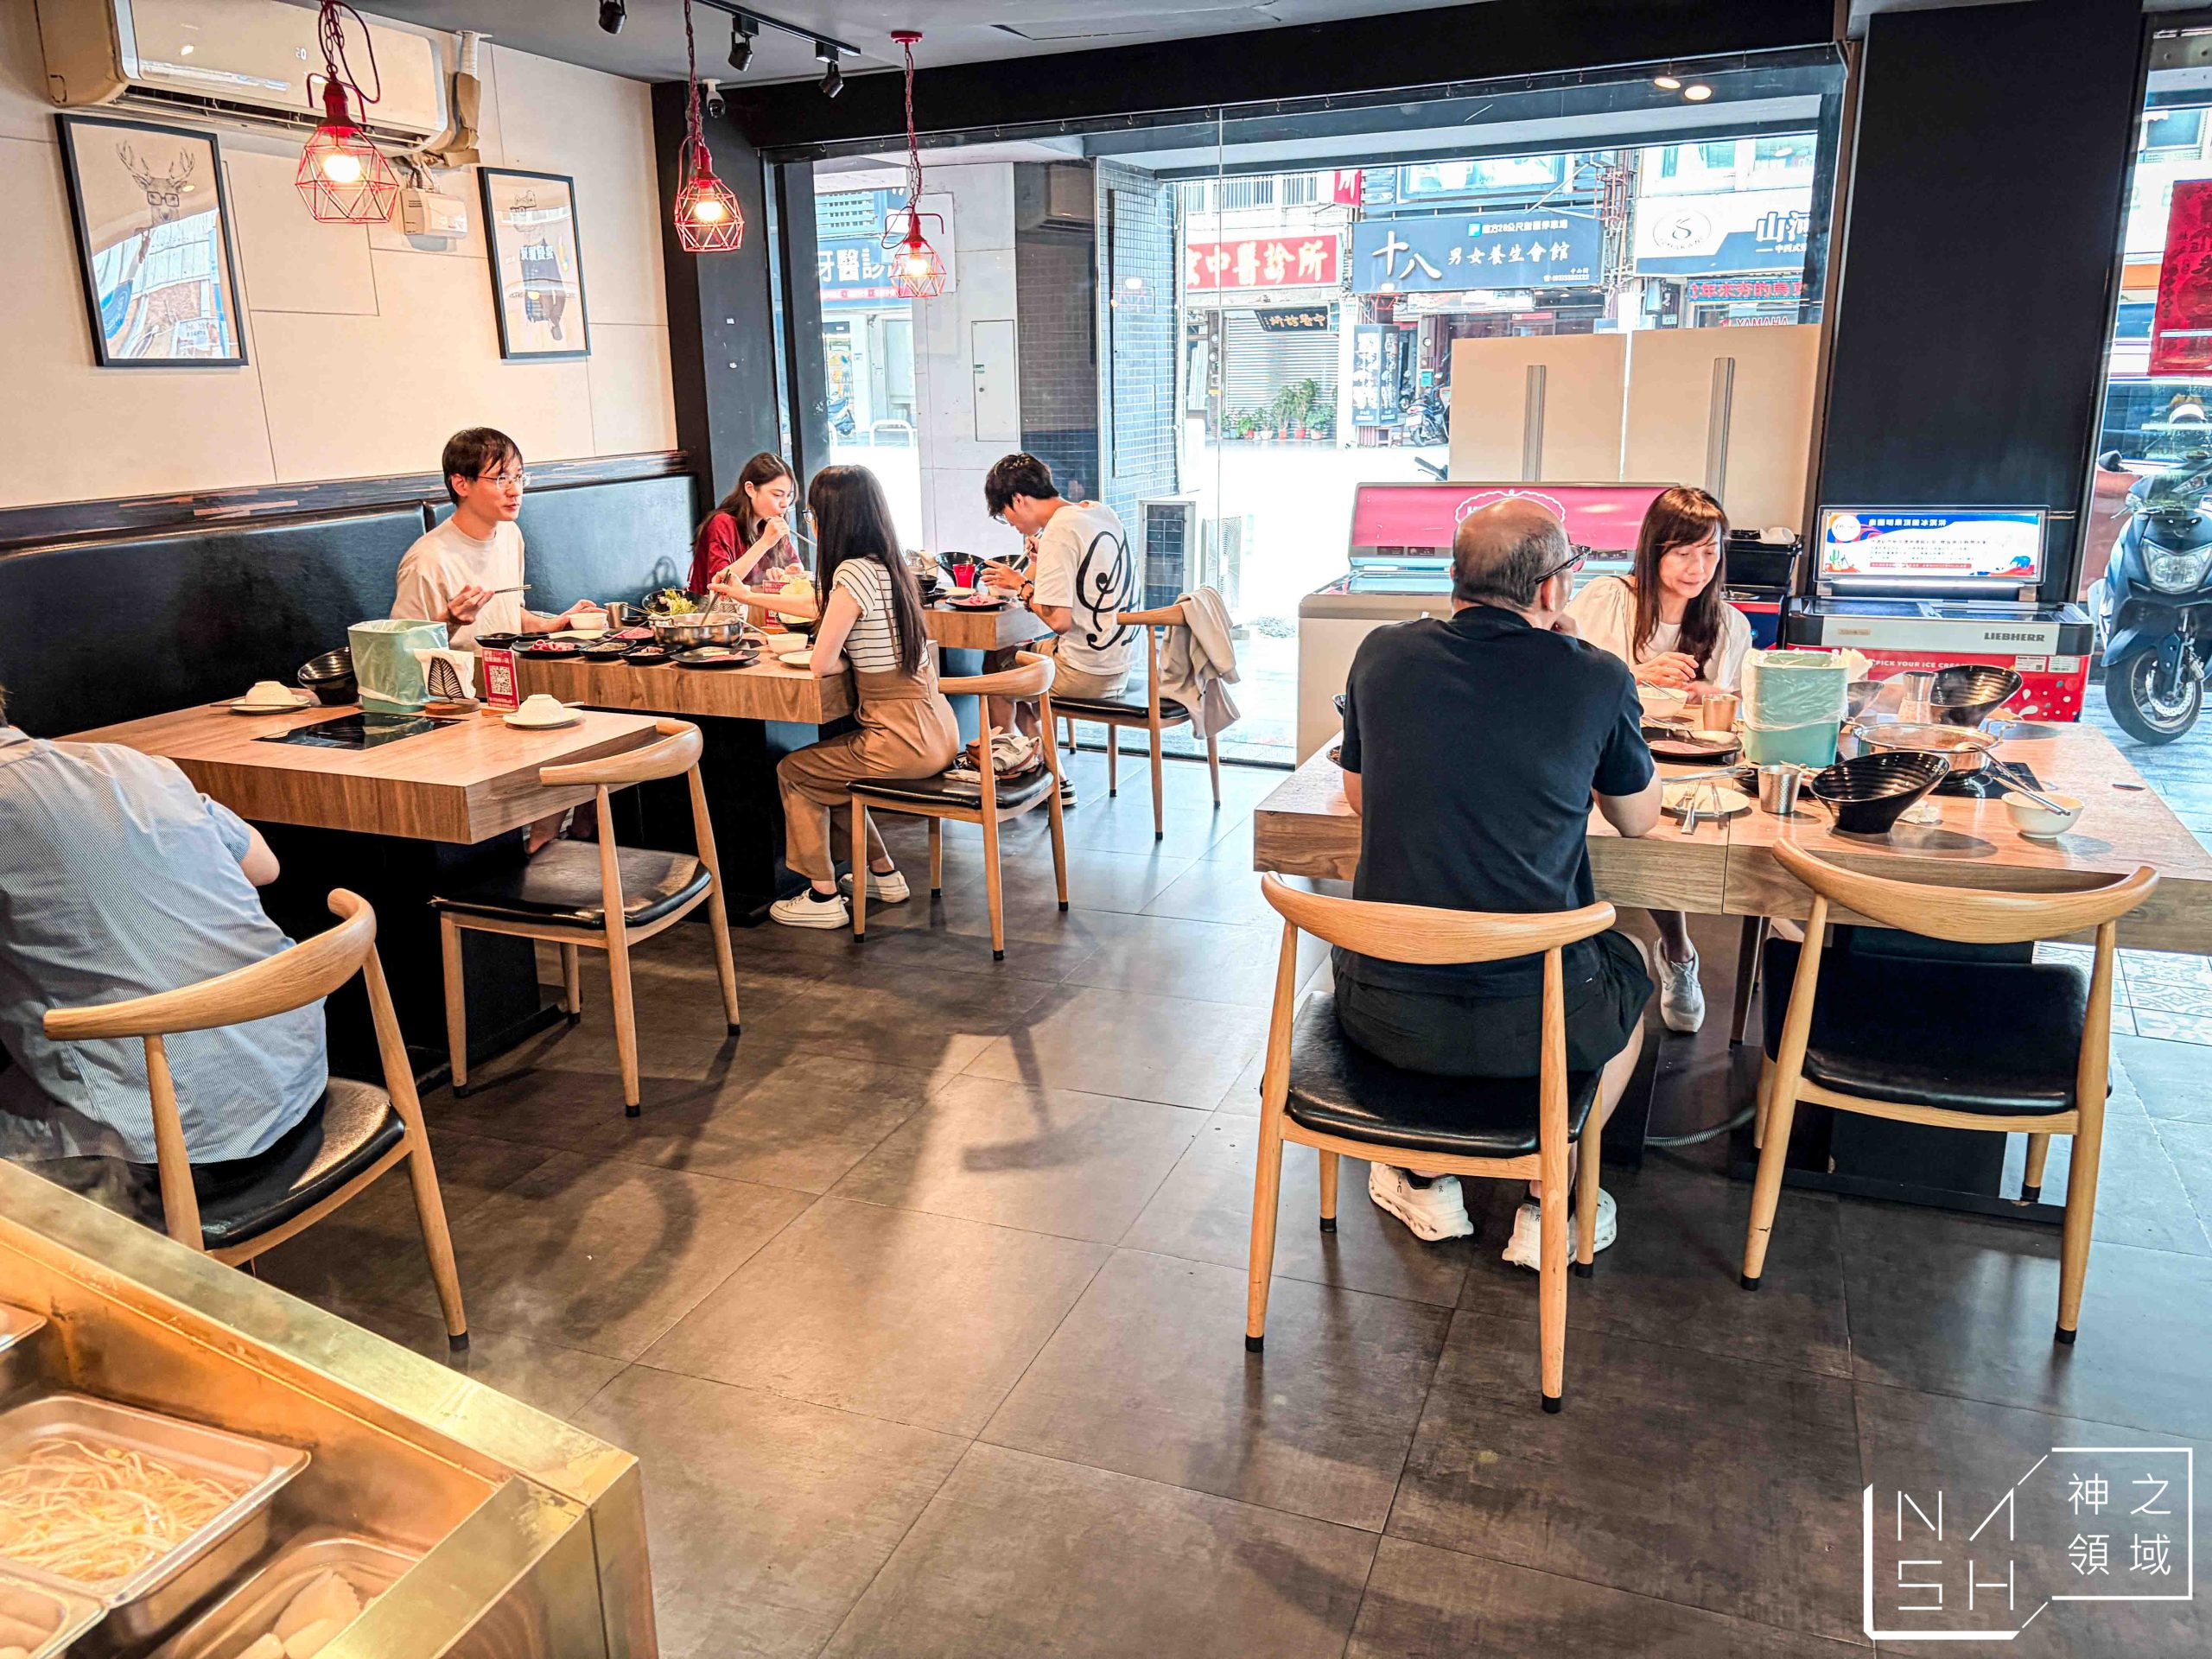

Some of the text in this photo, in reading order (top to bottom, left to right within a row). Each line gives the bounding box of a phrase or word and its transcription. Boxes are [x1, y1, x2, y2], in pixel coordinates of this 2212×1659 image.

[817, 248, 902, 283] 牙醫診
[1372, 230, 1570, 279] 十八 男女養生會館
[1984, 632, 2045, 642] LIEBHERR
